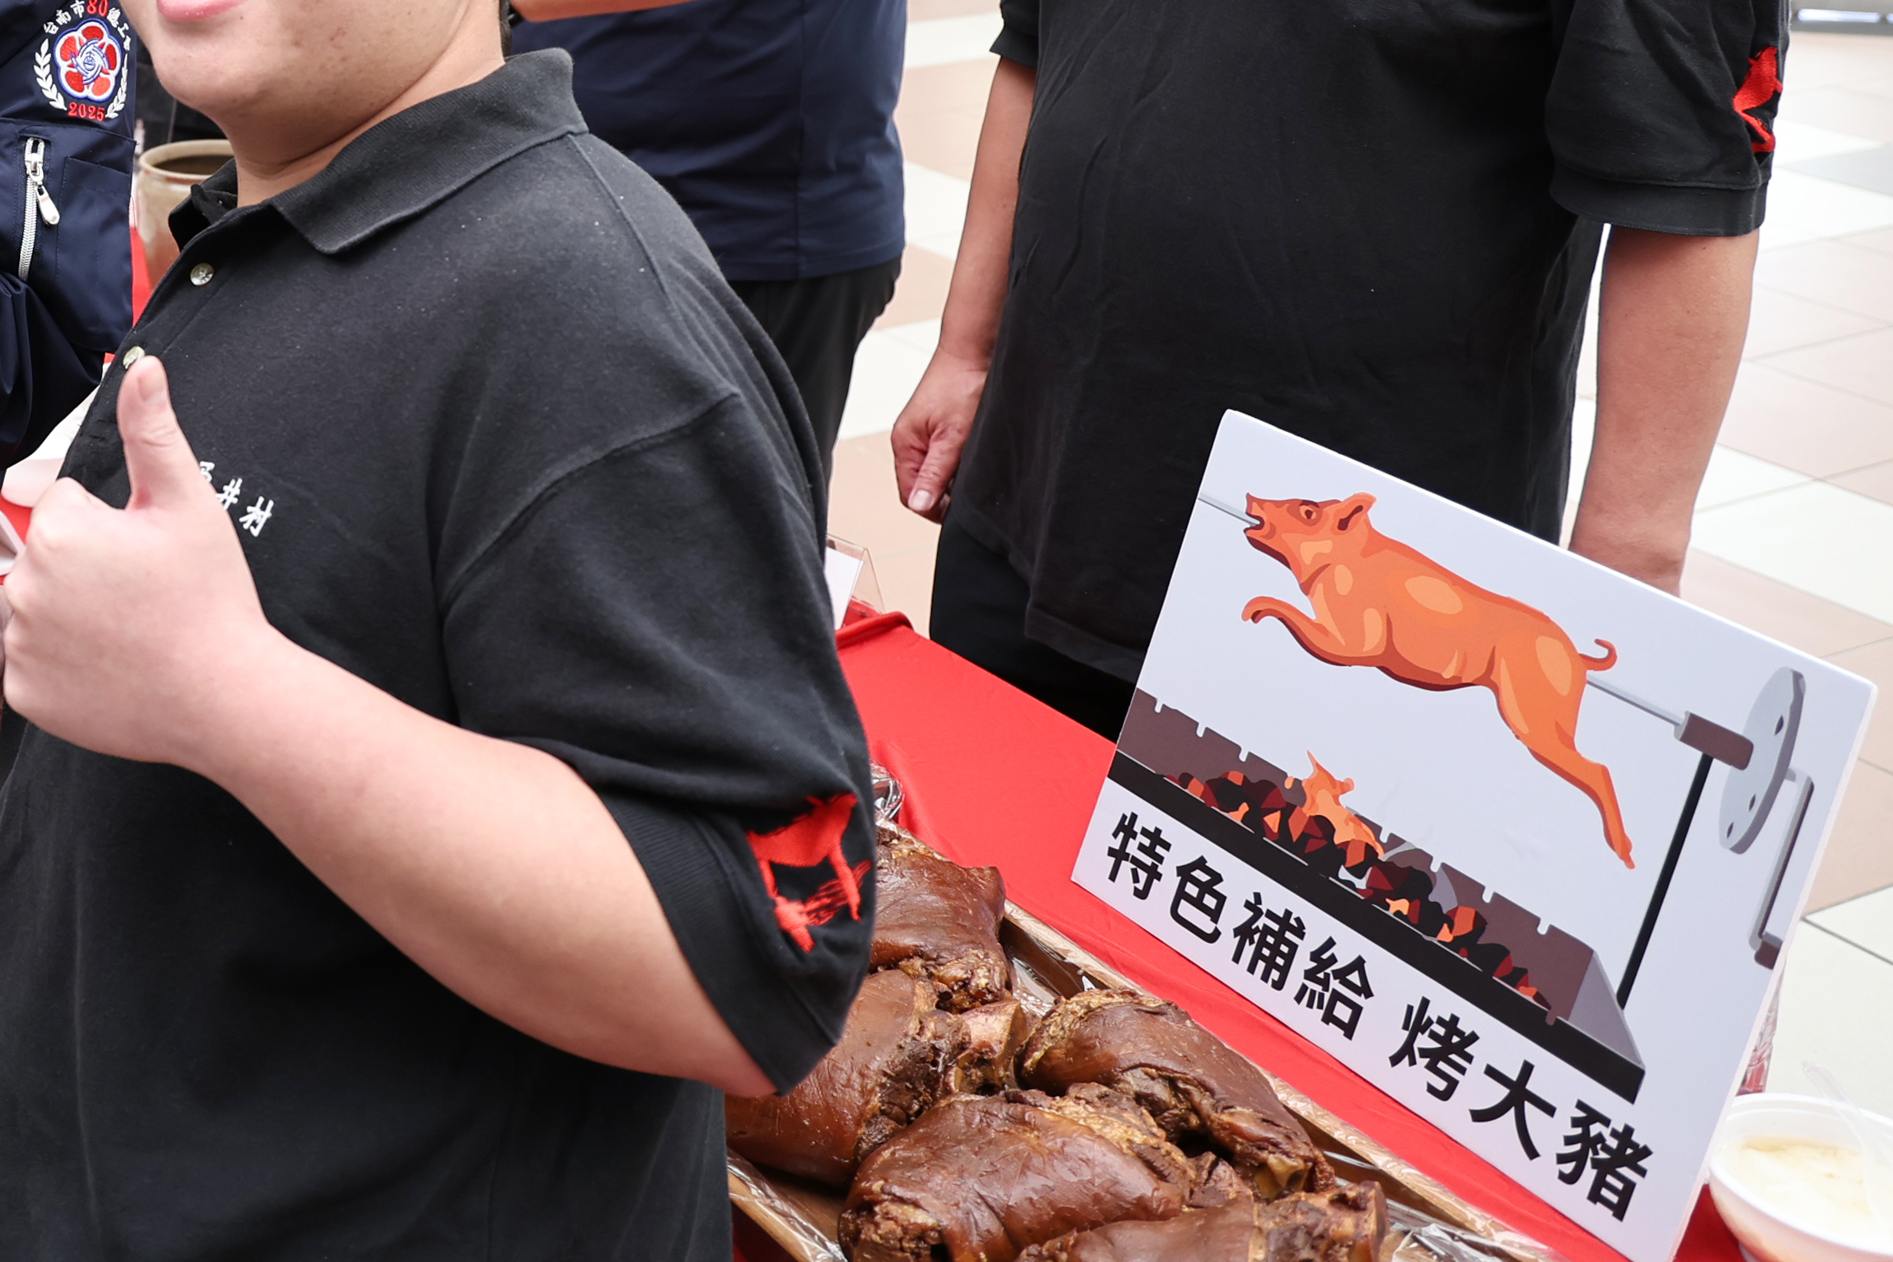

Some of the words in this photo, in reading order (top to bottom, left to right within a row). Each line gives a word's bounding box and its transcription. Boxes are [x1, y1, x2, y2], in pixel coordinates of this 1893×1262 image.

[67, 101, 106, 122] 2025
[1106, 811, 1375, 1041] 特色補給
[1388, 996, 1654, 1223] 烤大豬
